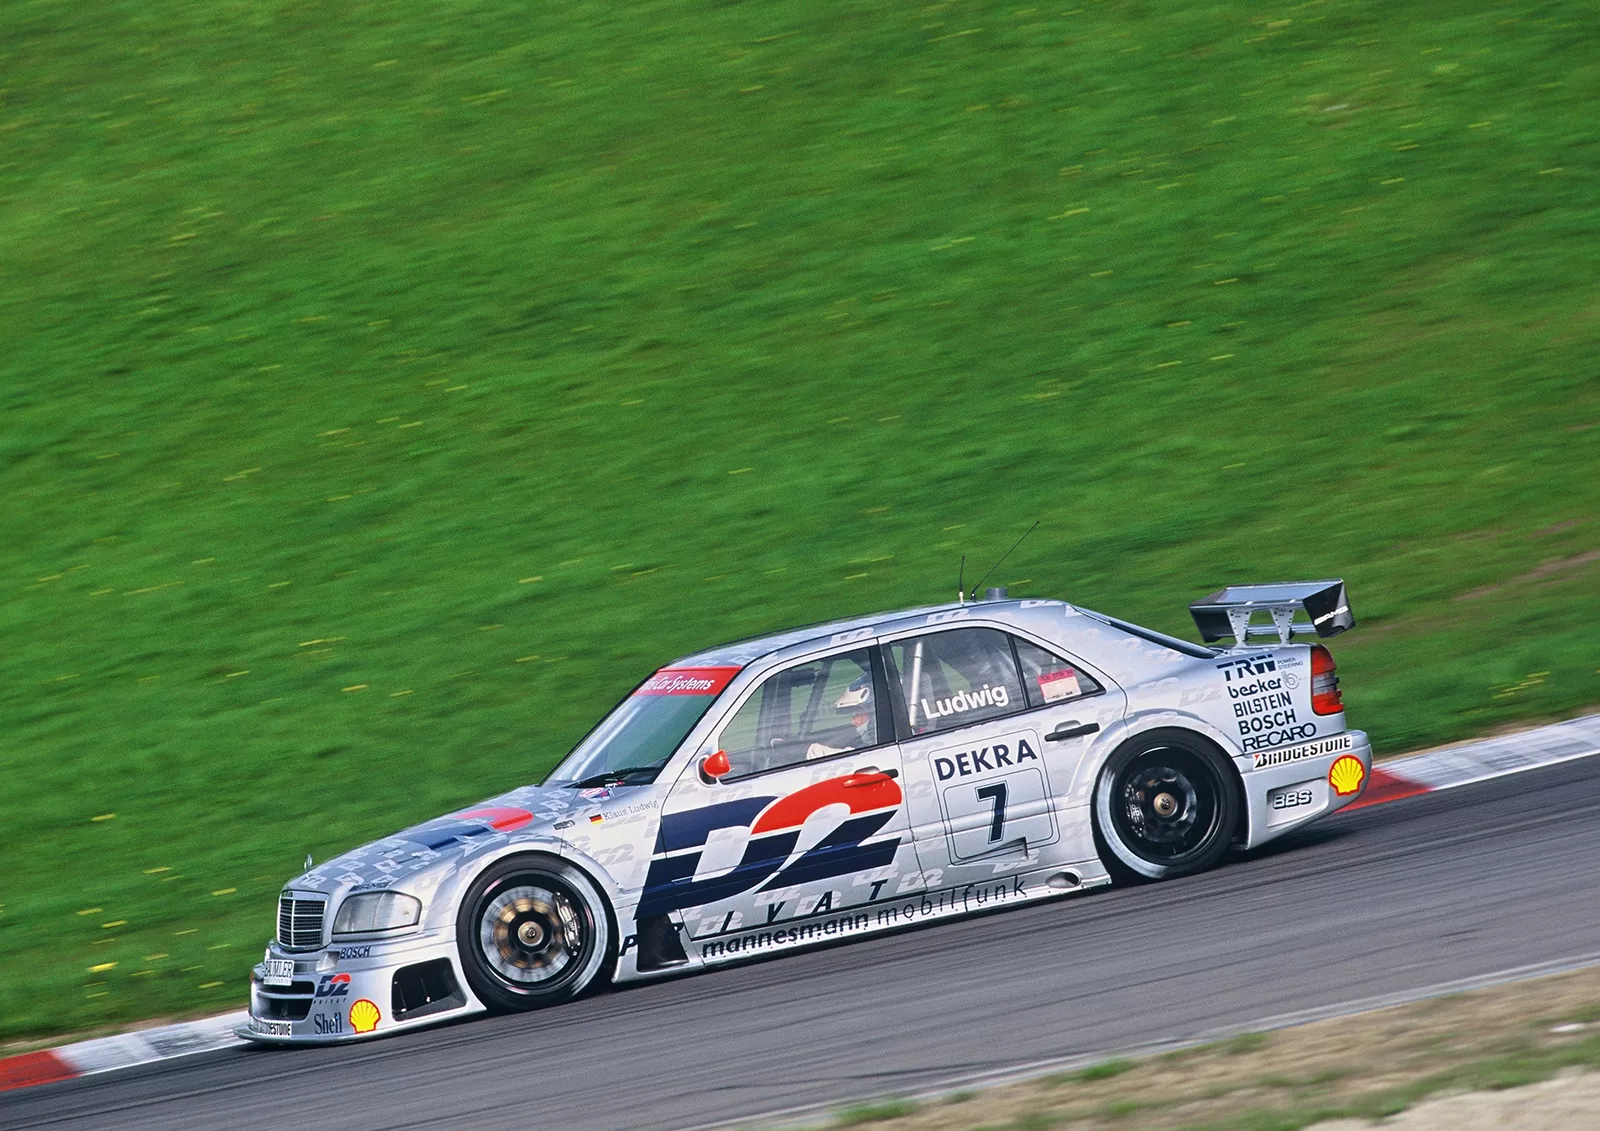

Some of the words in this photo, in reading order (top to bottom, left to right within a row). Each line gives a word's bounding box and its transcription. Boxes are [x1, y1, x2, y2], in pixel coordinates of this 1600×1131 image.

[1216, 654, 1276, 681] TRW
[667, 675, 715, 693] Systems
[1227, 678, 1282, 699] becker
[921, 684, 1009, 719] Ludwig
[1233, 691, 1292, 717] BILSTEIN
[1238, 709, 1297, 735] BOSCH
[1242, 723, 1316, 752] RECARO
[934, 739, 1038, 781] DEKRA
[1254, 737, 1351, 768] BRIDGESTONE
[603, 809, 628, 821] Klaus
[628, 800, 660, 813] Ludwig
[1273, 789, 1312, 809] BBS
[976, 781, 1008, 844] 7
[633, 772, 902, 920] D2
[702, 912, 869, 958] mannesmann
[877, 875, 1027, 925] mobilfunk
[340, 945, 371, 959] BOSCH
[315, 973, 352, 997] D2
[314, 1012, 343, 1034] Shell
